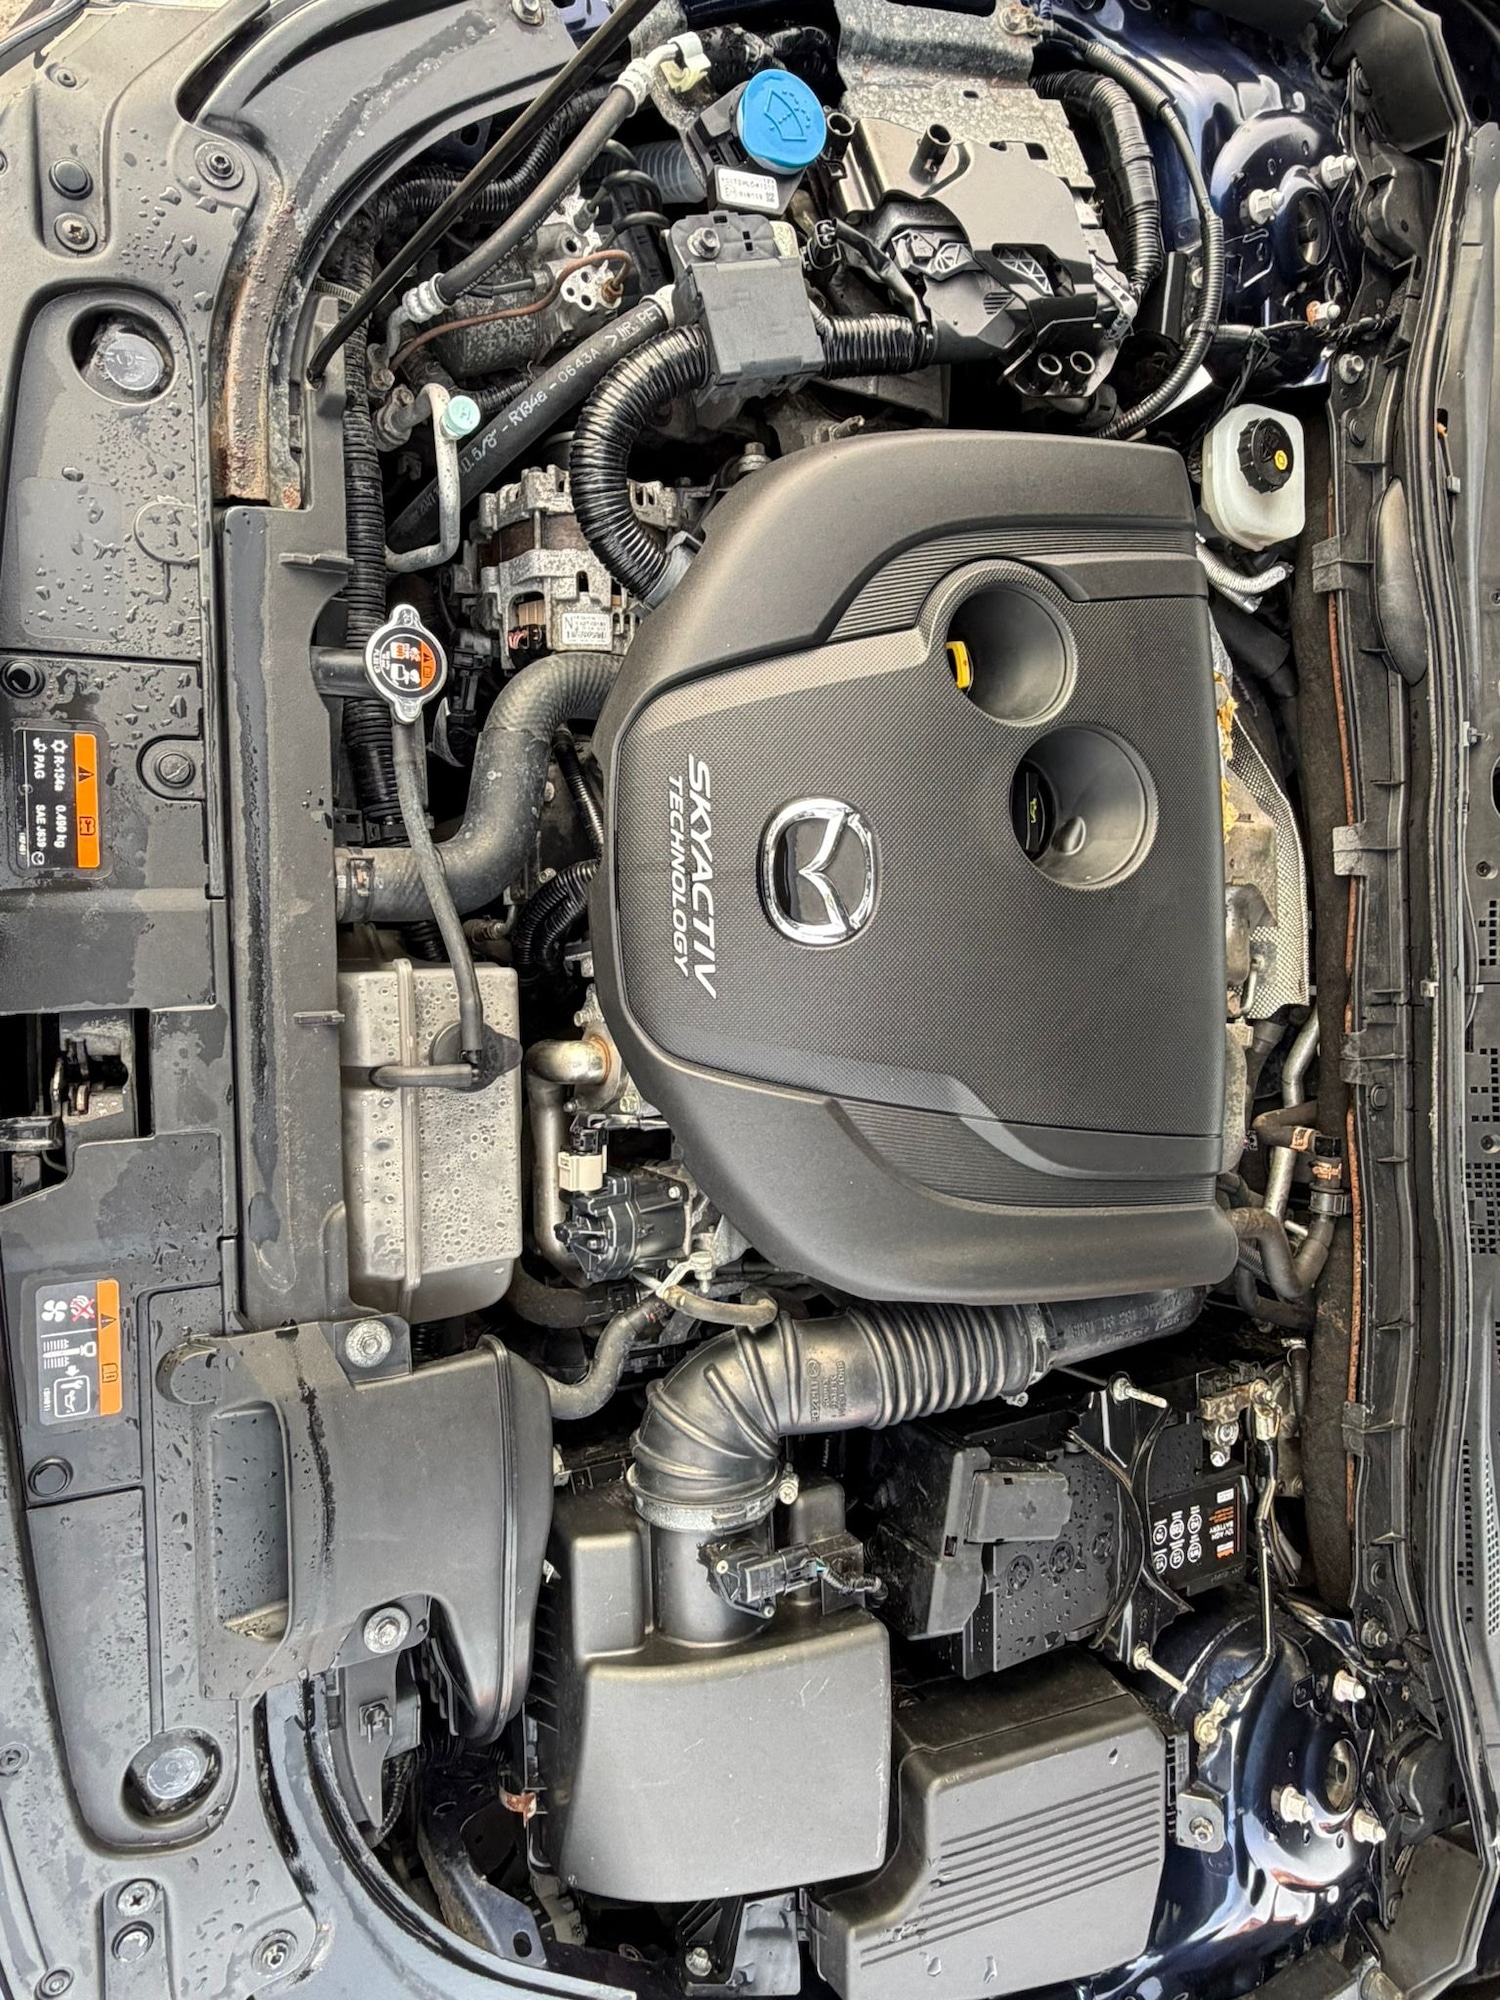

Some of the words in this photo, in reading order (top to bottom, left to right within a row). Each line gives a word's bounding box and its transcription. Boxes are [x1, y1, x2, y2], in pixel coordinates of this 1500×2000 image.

[557, 347, 602, 384] 0643A
[34, 754, 45, 780] PAG
[53, 755, 65, 792] R-134a
[35, 804, 46, 825] SAE
[55, 804, 67, 833] 0.490
[36, 826, 46, 848] J639
[54, 834, 67, 849] kg
[669, 775, 688, 977] TECHNOLOGY
[688, 753, 716, 999] SKYACTIV
